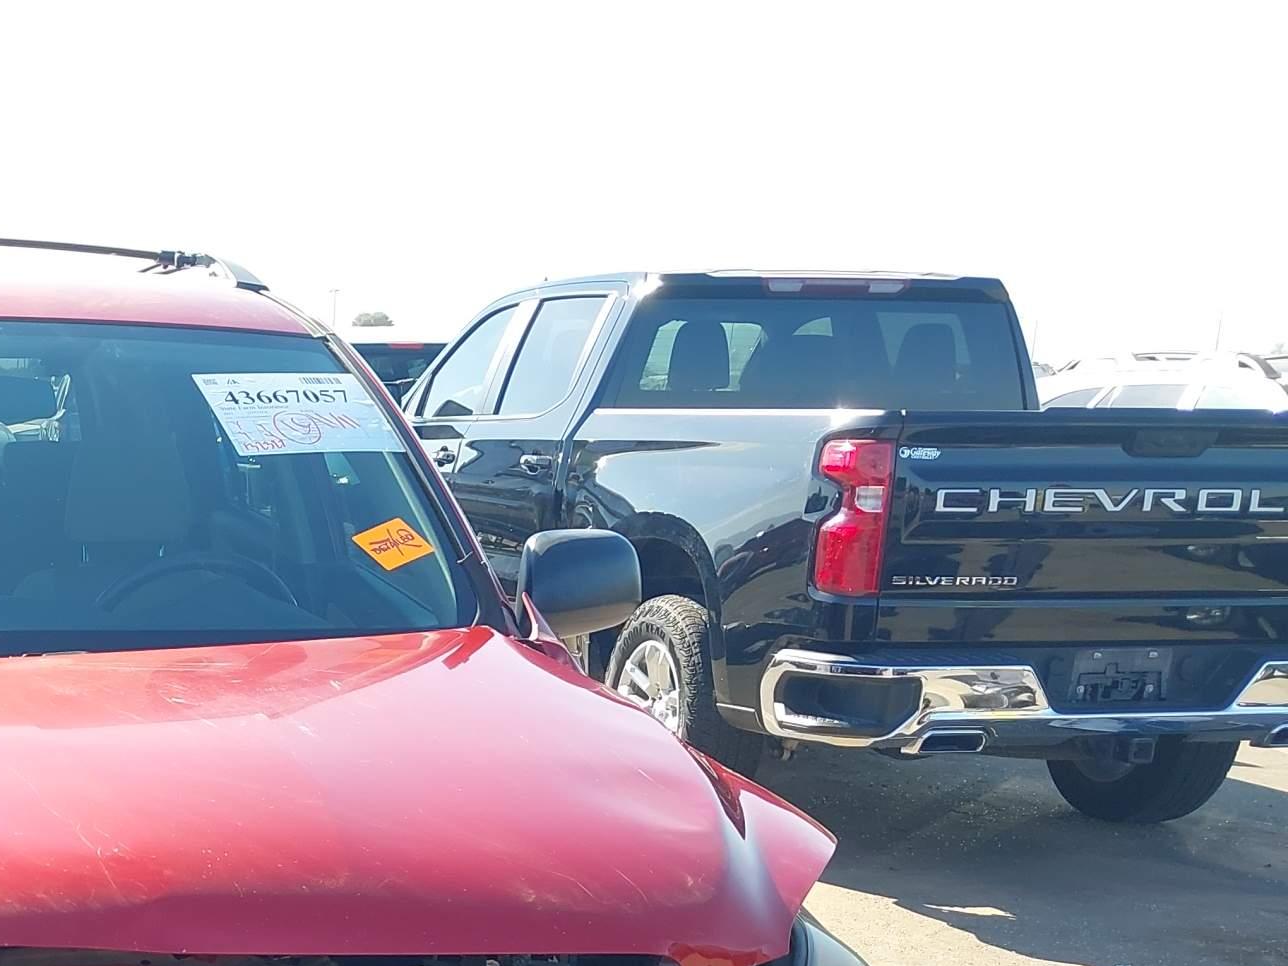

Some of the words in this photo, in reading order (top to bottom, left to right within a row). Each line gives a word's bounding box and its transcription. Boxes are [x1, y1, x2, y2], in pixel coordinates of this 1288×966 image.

[224, 389, 348, 405] 43667057
[935, 488, 1285, 512] CHEVROL
[891, 575, 1018, 586] SILVERADO
